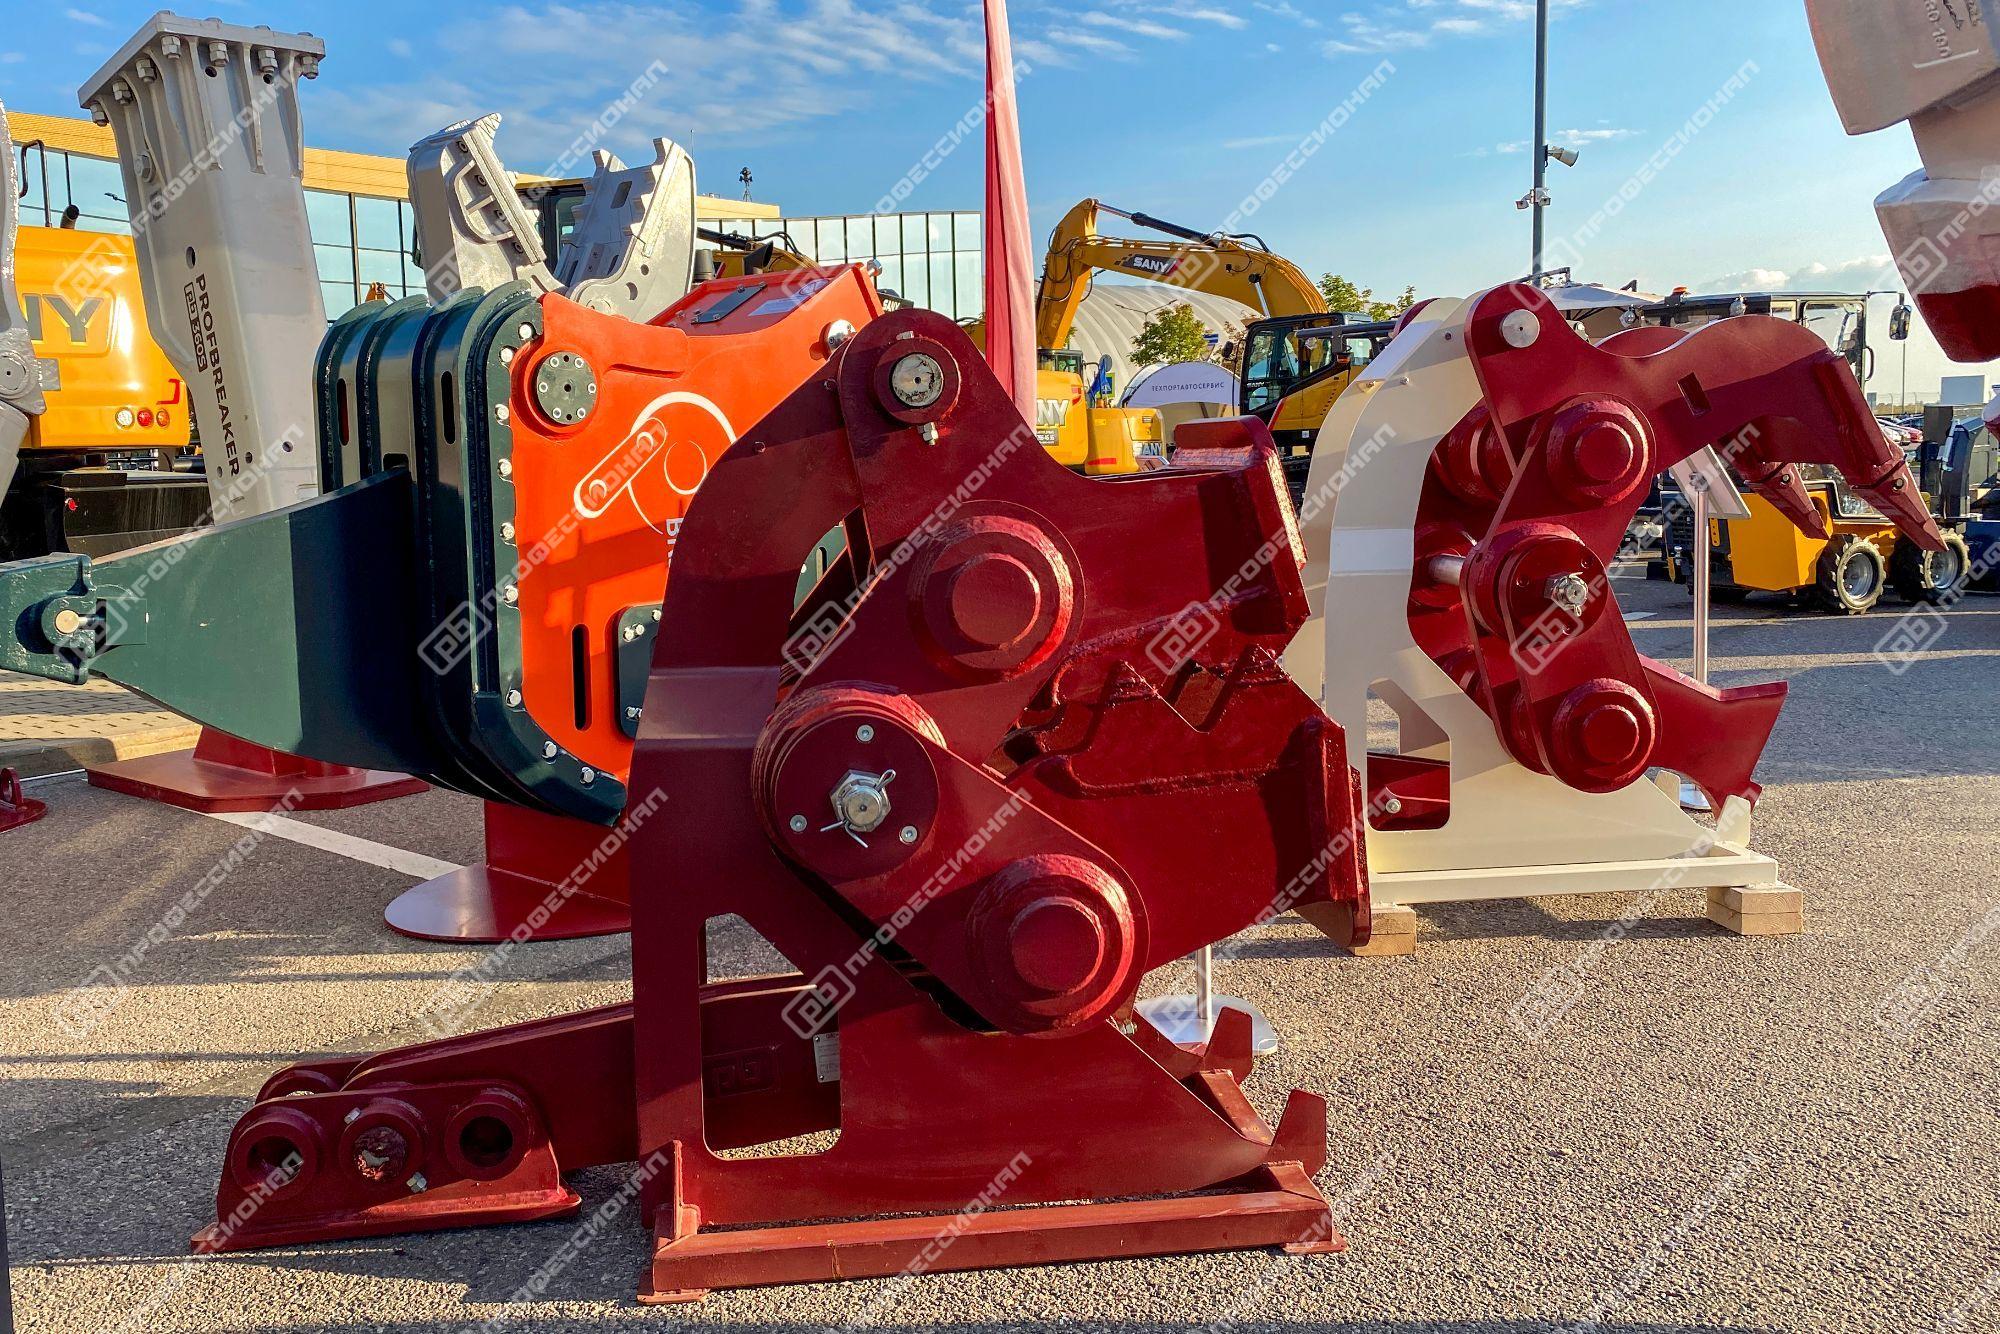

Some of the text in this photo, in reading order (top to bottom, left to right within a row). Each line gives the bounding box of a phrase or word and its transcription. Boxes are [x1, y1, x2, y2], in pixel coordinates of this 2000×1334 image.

[1133, 256, 1170, 273] SANY
[191, 320, 207, 370] 360S
[195, 273, 240, 477] PROFBREAKER
[1151, 382, 1225, 392] ТЕХПОРТАВТОСЕРВИС
